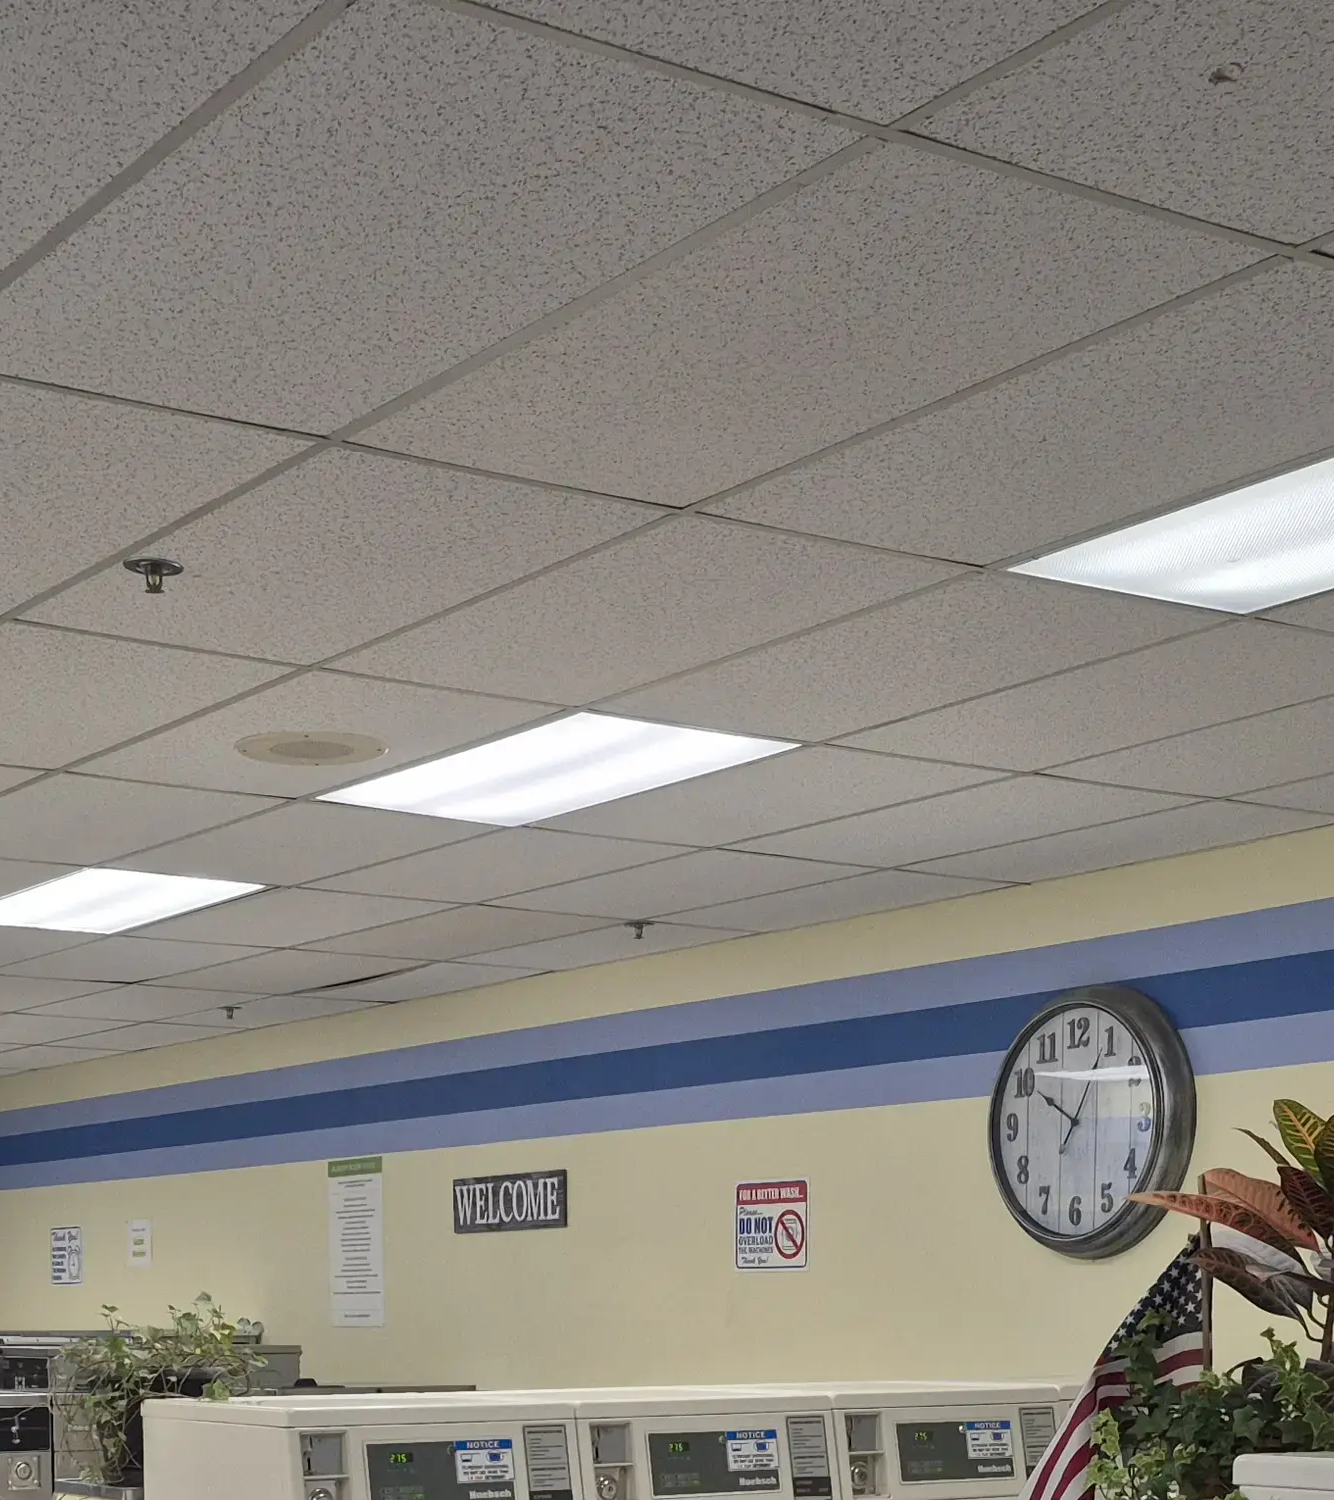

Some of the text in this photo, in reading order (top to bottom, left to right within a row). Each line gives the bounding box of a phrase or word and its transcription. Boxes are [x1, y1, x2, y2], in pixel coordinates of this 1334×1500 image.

[1067, 1016, 1091, 1049] 12
[1103, 1025, 1116, 1057] 1
[1036, 1032, 1058, 1065] 11
[1014, 1067, 1035, 1099] 10
[1006, 1113, 1019, 1142] 9
[1137, 1101, 1152, 1132] 3
[1017, 1155, 1030, 1185] 8
[1123, 1148, 1138, 1179] 4
[455, 1177, 560, 1226] WELCOME
[1039, 1185, 1051, 1216] 7
[1068, 1195, 1082, 1227] 6
[1101, 1181, 1114, 1213] 5
[738, 1235, 773, 1246] OVERLOAD
[739, 1216, 773, 1234] DO NOT
[467, 1441, 500, 1449] NOTICE
[736, 1431, 765, 1439] NOTICE
